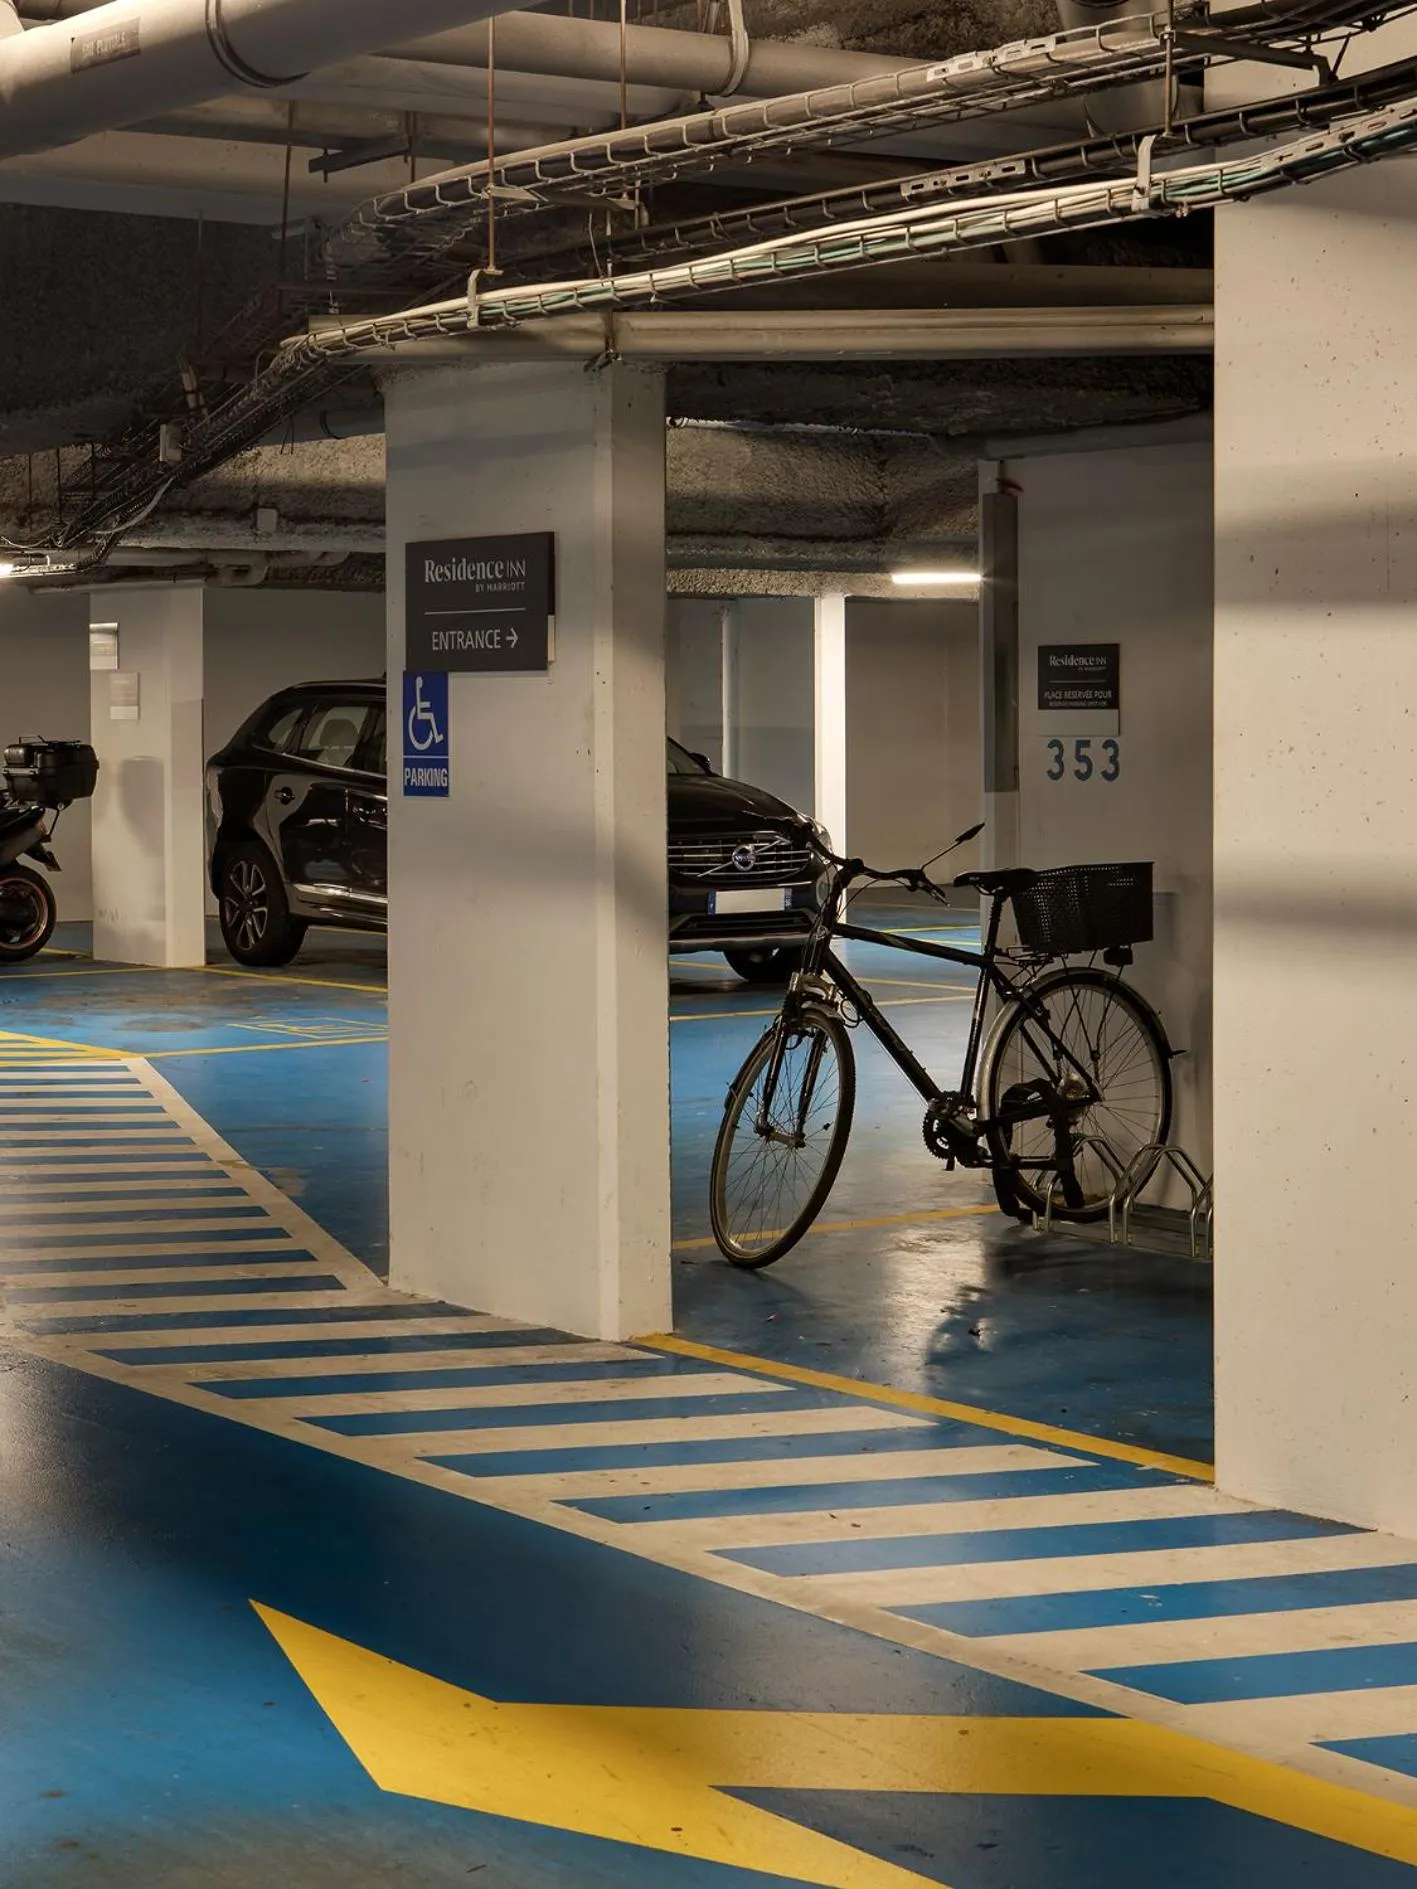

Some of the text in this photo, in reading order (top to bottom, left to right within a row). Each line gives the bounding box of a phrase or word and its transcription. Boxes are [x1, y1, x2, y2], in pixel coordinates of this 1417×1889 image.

[424, 557, 526, 583] Residence INN
[475, 583, 485, 593] BY
[432, 629, 501, 651] ENTRANCE
[1049, 654, 1095, 667] Residence
[1046, 738, 1120, 782] 353
[404, 767, 448, 787] PARKING
